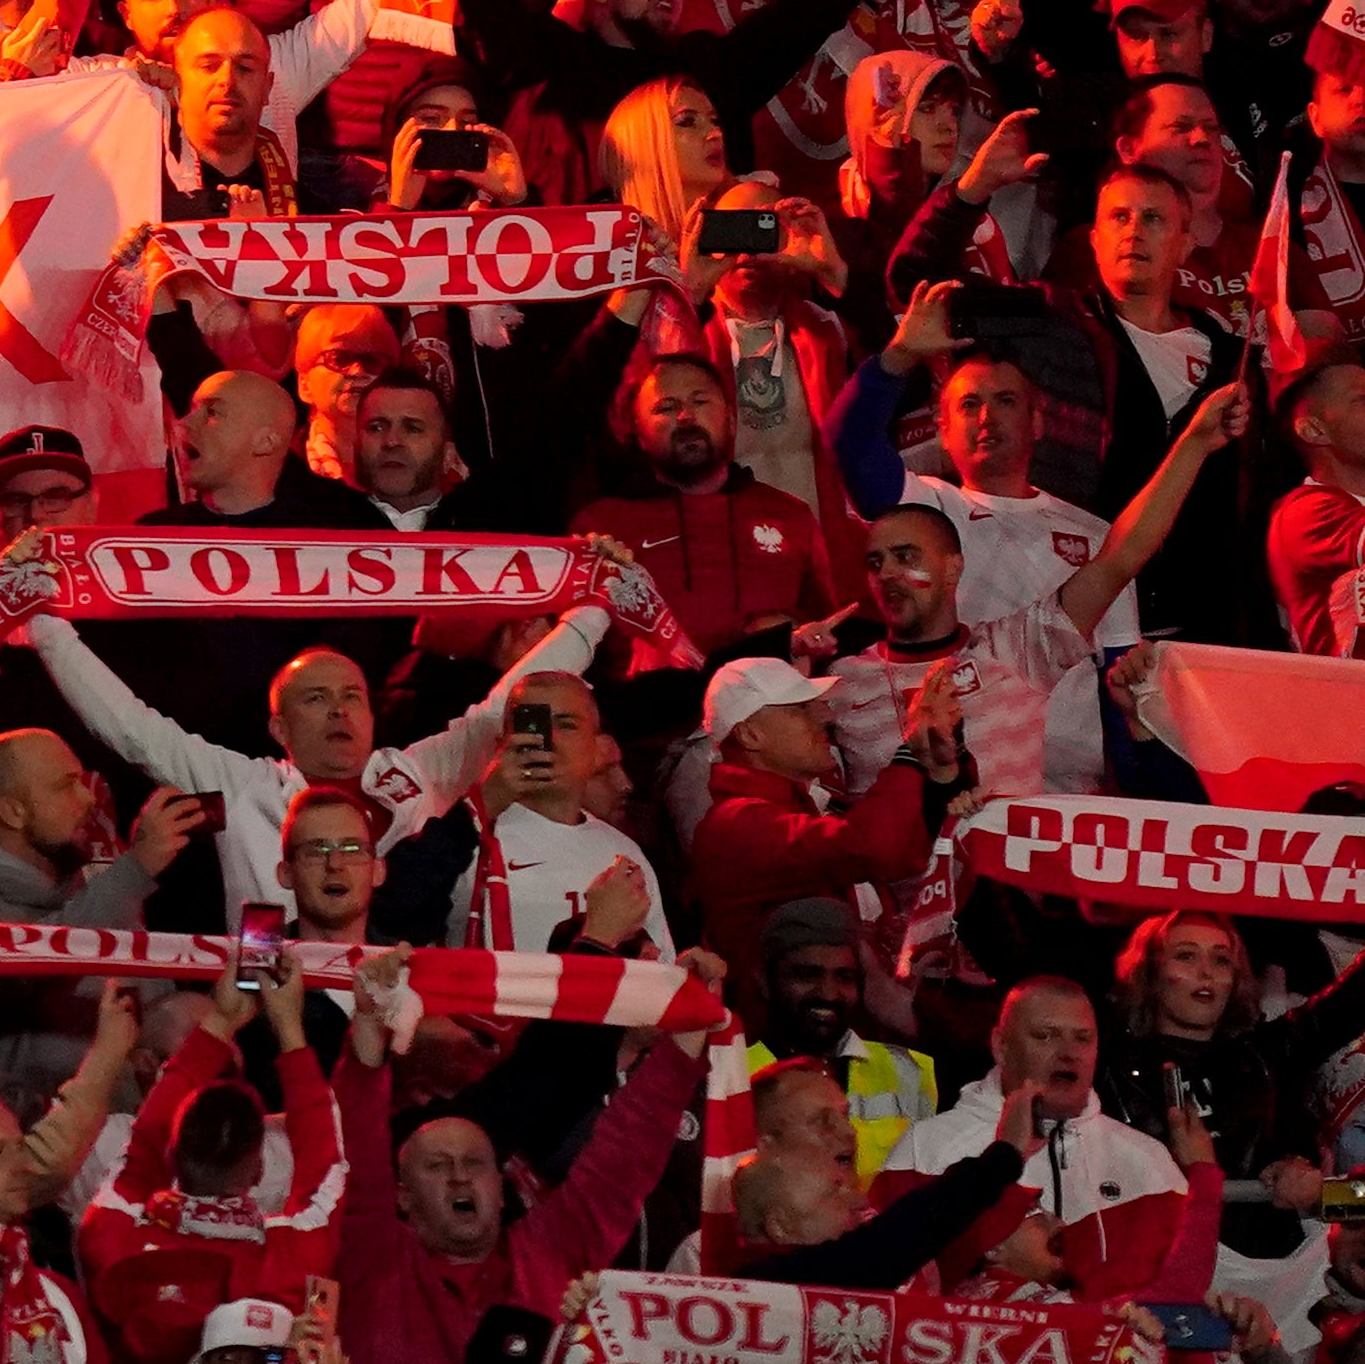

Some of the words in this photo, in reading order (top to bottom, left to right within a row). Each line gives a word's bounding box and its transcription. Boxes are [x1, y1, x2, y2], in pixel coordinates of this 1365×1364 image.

[174, 211, 622, 299] POLSKA
[619, 211, 640, 283] BIAŁO
[62, 533, 92, 606] BIAŁO
[114, 545, 549, 596] POLSKA
[1005, 804, 1365, 903] POLSKA
[623, 1292, 792, 1355] POL
[906, 1320, 1071, 1364] SKA
[945, 1301, 1050, 1324] WIERNI
